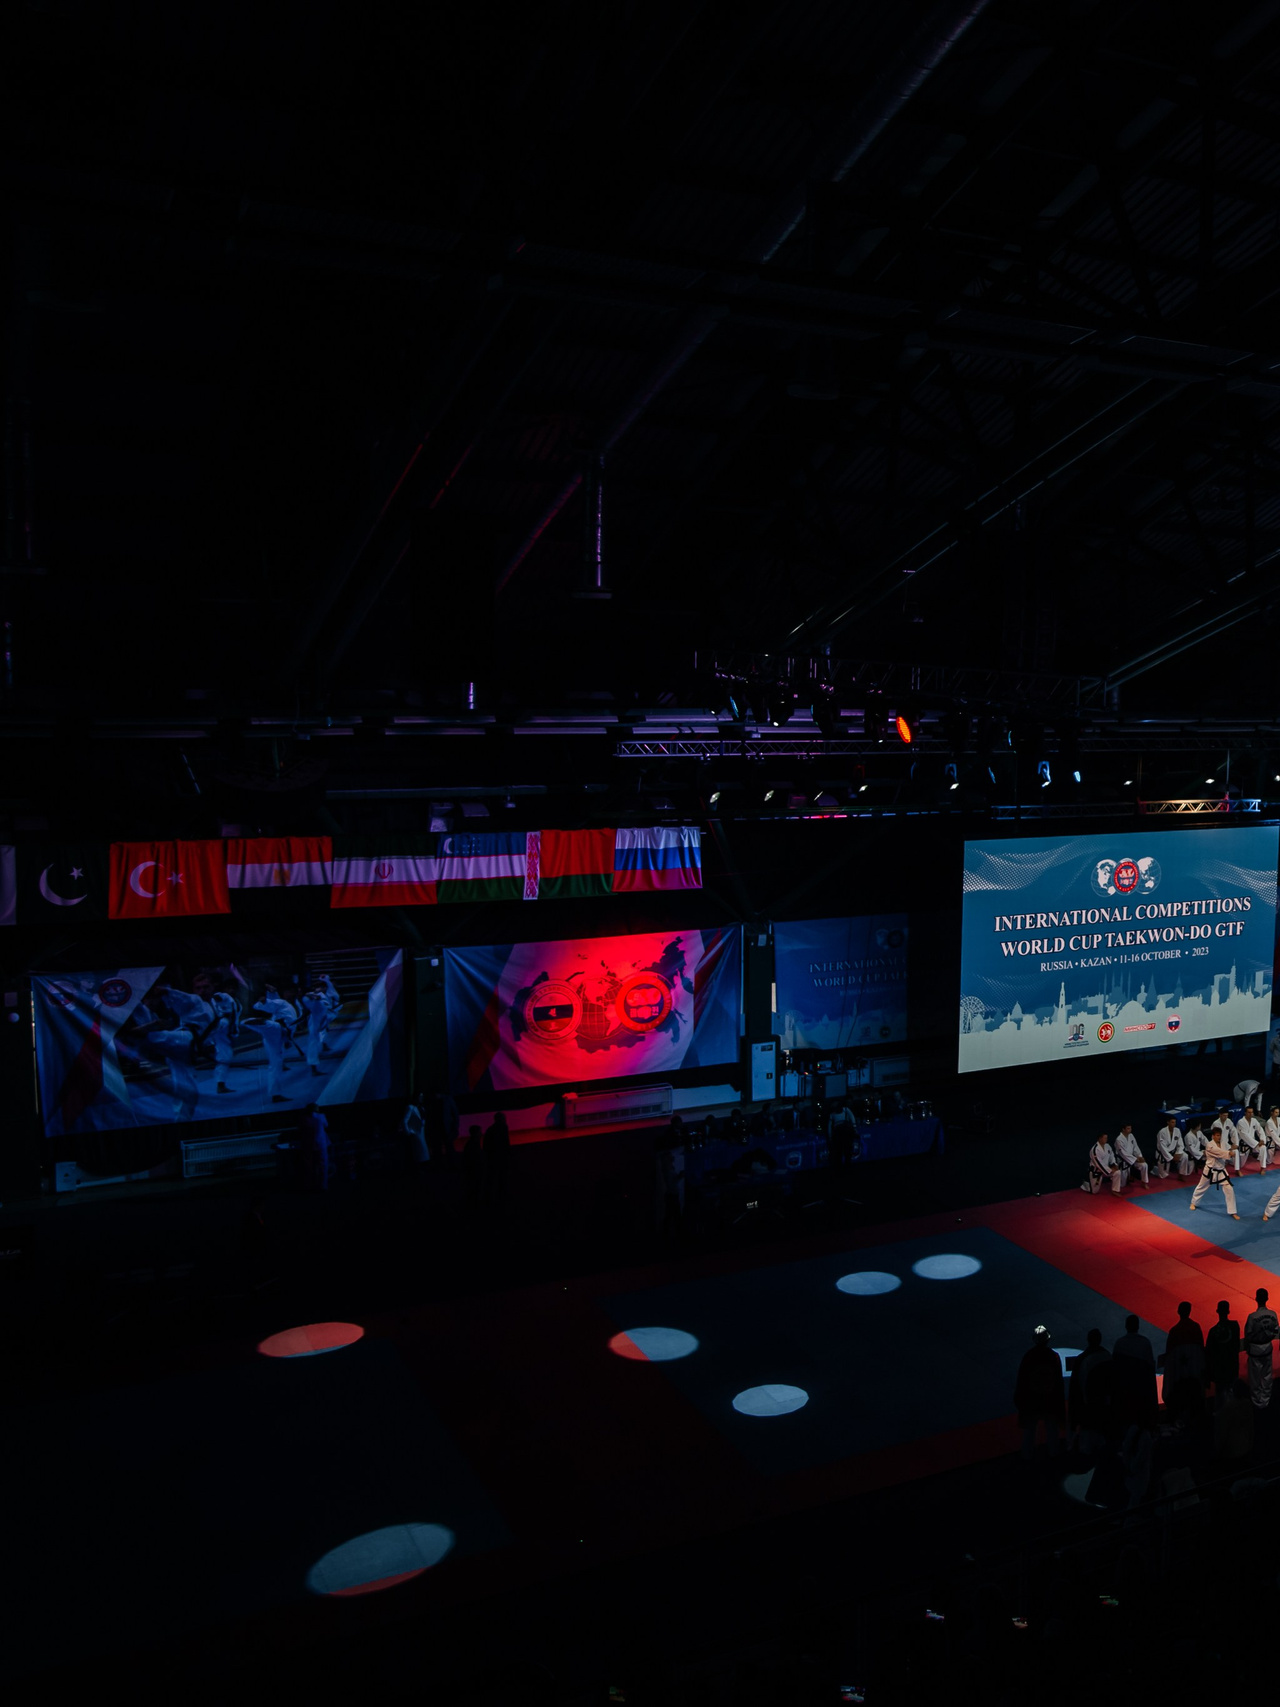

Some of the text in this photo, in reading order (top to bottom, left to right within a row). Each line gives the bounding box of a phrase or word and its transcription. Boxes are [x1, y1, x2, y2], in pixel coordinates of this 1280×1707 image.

[994, 896, 1251, 932] INTERNATIONAL COMPETITIONS
[1000, 921, 1245, 957] WORLD CUP TAEKWON-DO GTF
[1040, 946, 1210, 972] RUSSIA KAZAN 11-16 OCTOBER 2023
